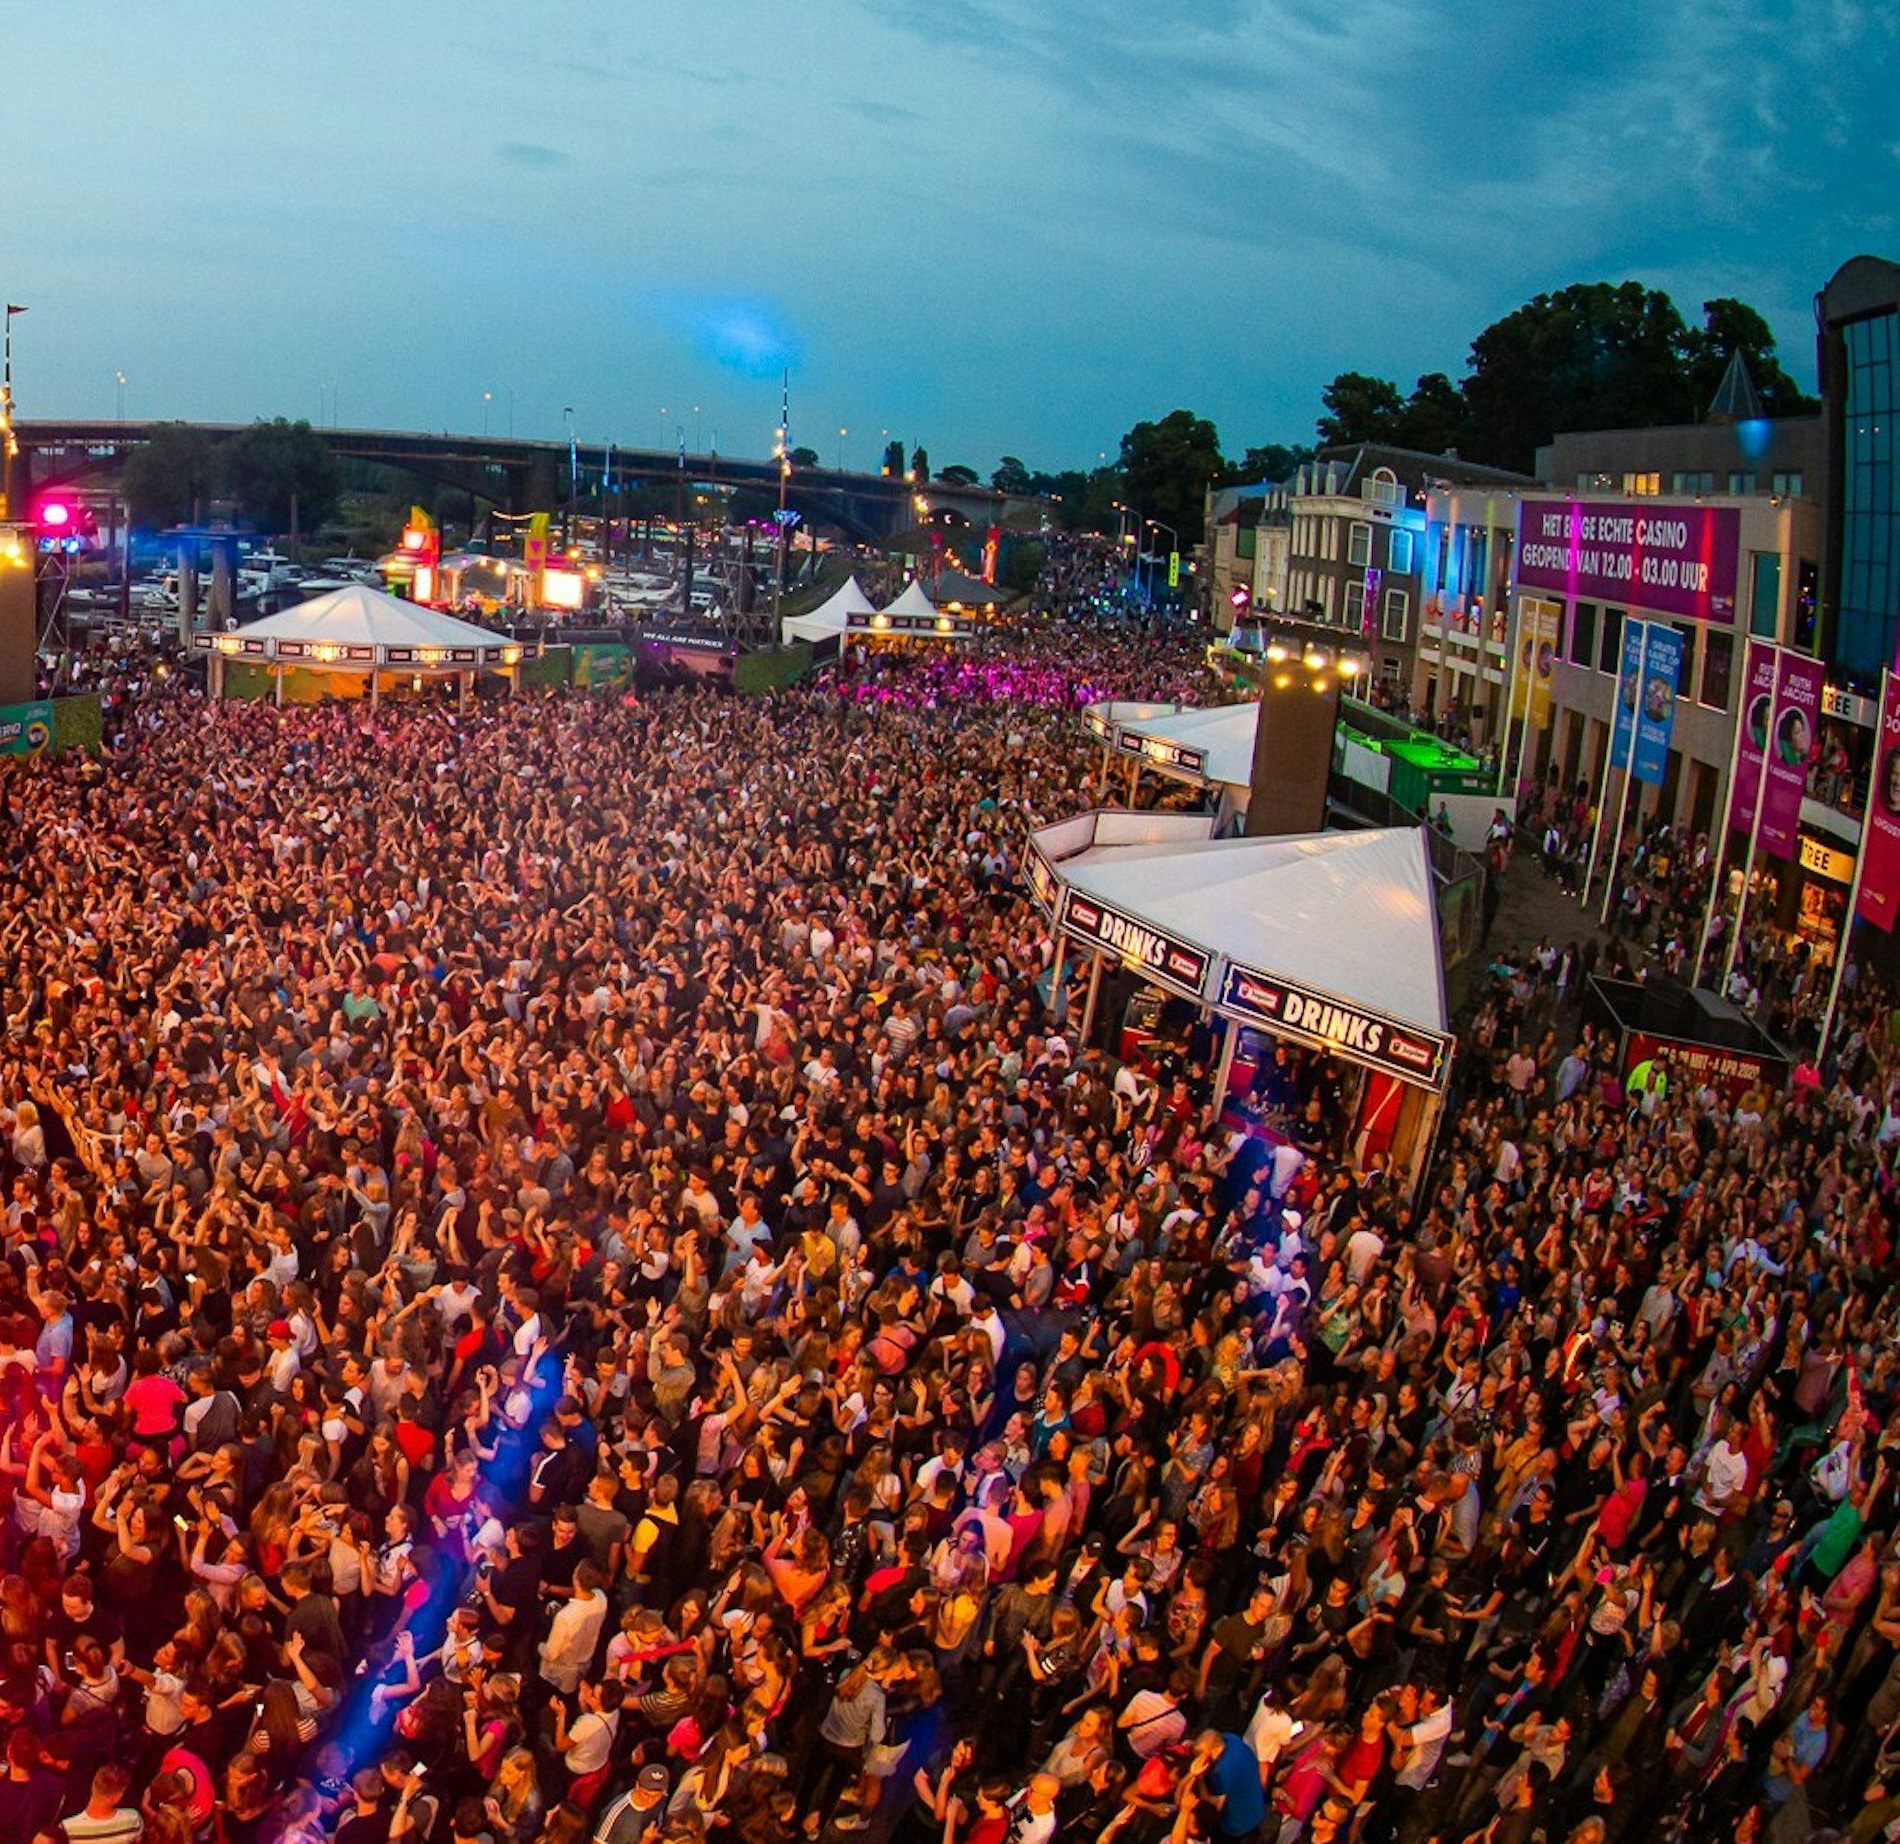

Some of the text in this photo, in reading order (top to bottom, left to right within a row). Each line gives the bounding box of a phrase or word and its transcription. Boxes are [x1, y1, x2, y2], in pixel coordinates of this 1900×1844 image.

[1542, 514, 1563, 538] HET
[1599, 517, 1634, 544] ECHTE
[1635, 519, 1687, 550] CASINO
[1522, 543, 1572, 571] GEOPEND
[1602, 552, 1632, 581] 12.00
[1641, 557, 1677, 589] 03.00
[1680, 561, 1708, 593] UUR
[1099, 911, 1167, 966] DRINKS
[1282, 992, 1384, 1053] DRINKS
